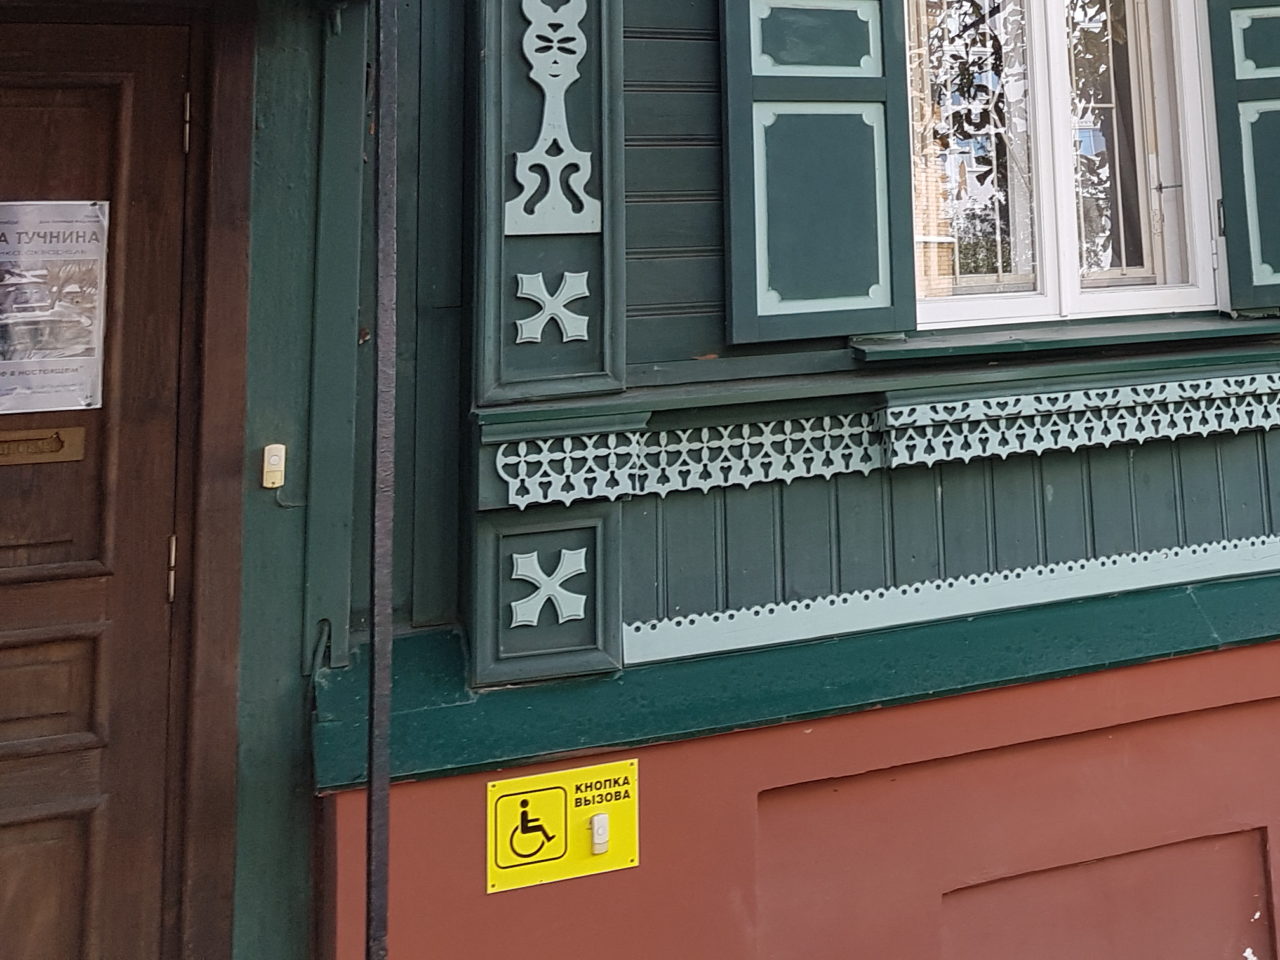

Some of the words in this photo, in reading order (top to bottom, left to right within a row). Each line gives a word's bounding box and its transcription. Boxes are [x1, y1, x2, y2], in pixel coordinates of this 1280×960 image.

[16, 230, 101, 245] ТУЧНИНА
[574, 775, 631, 795] КНОПКА
[573, 789, 631, 808] ВЫЗОВА
